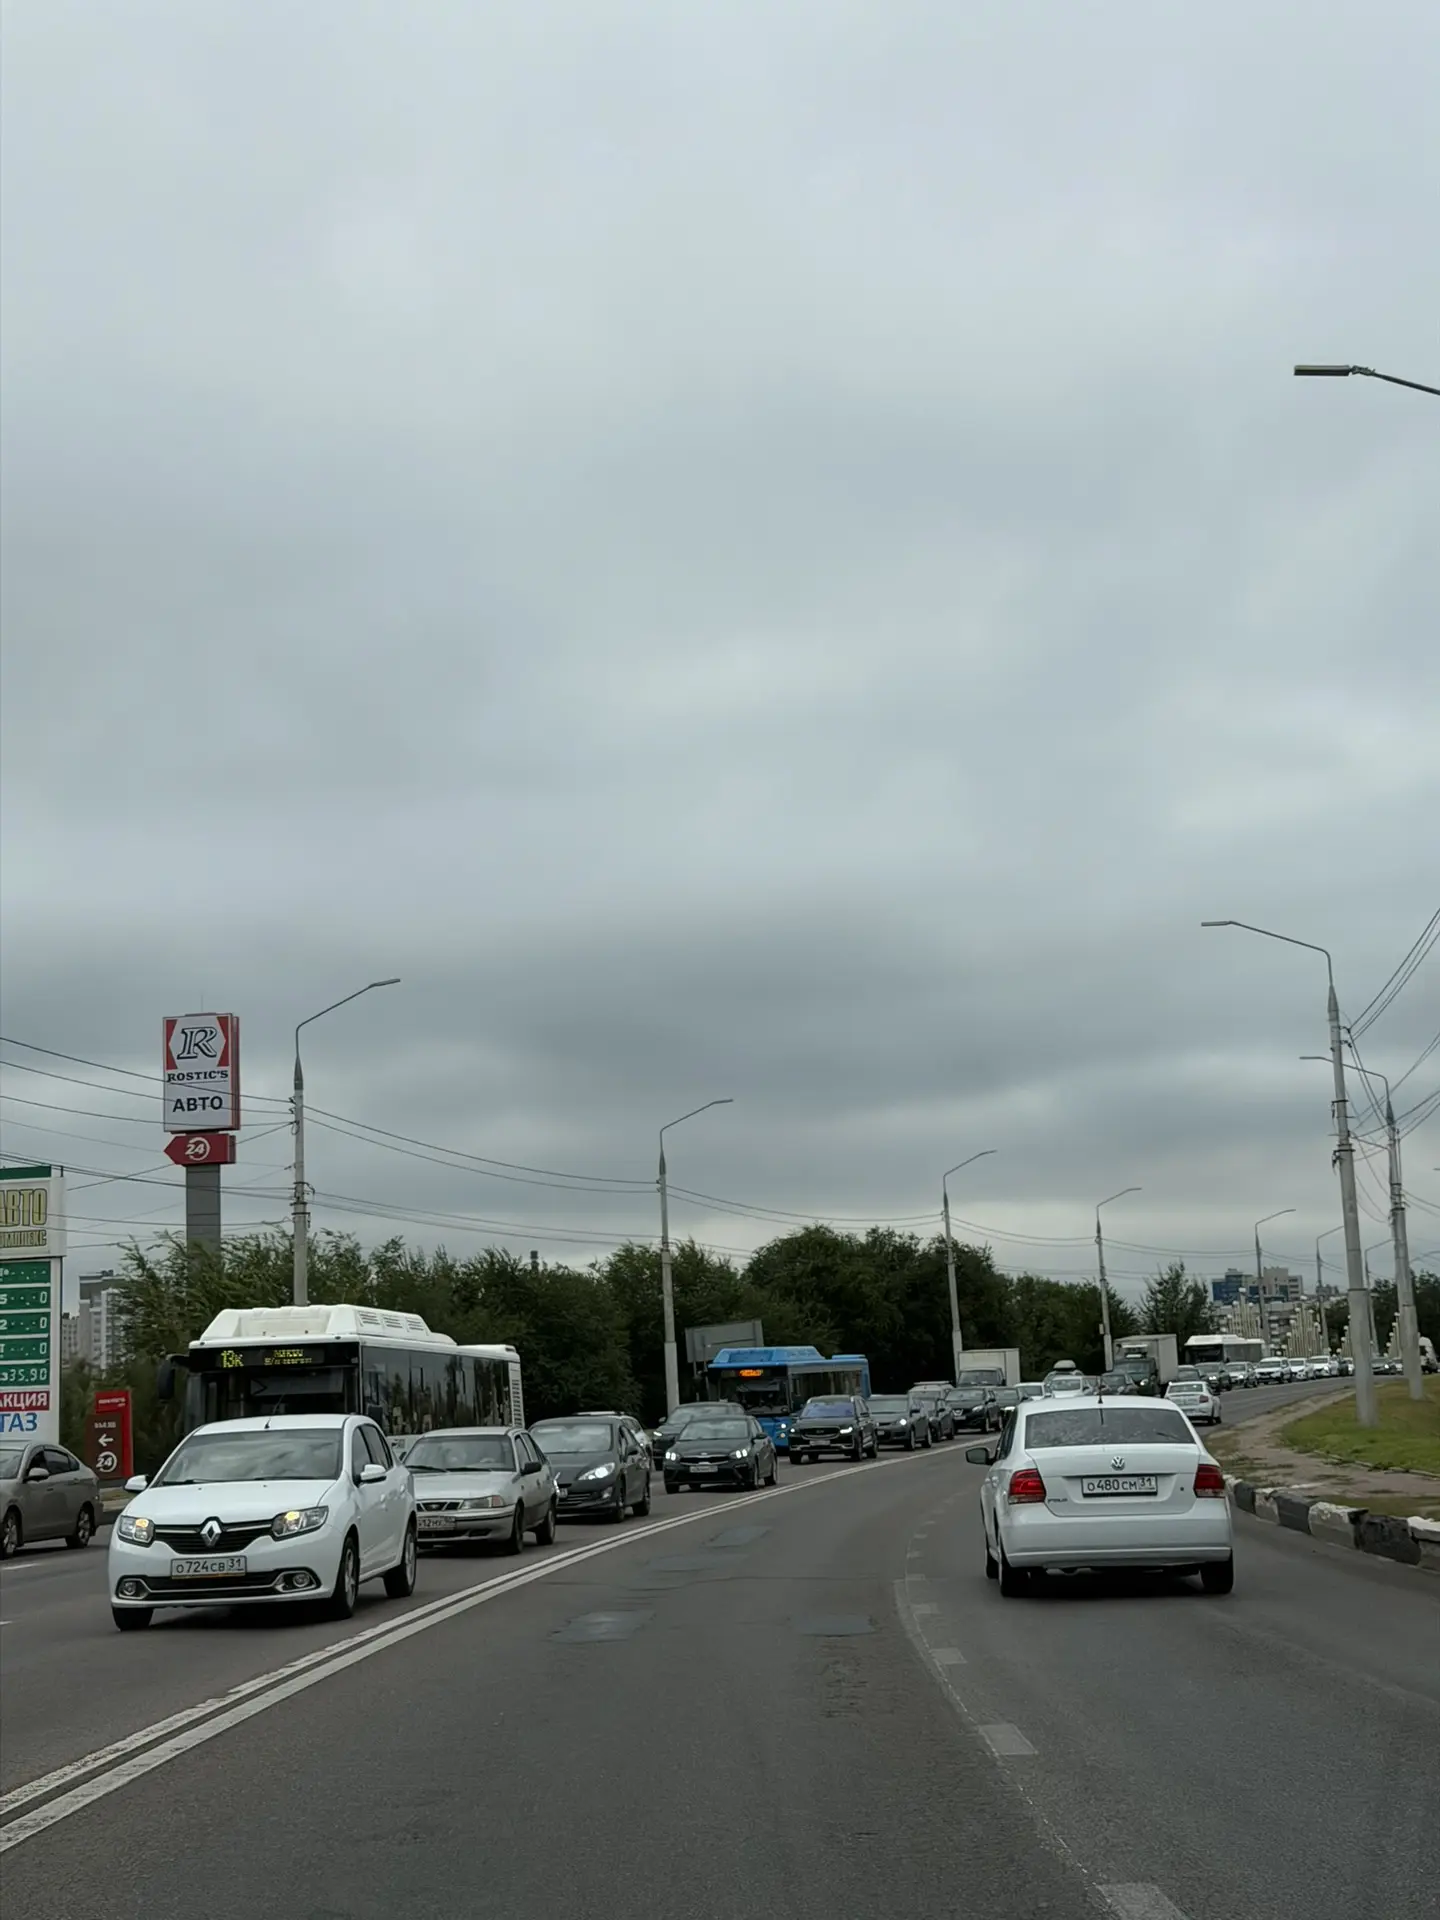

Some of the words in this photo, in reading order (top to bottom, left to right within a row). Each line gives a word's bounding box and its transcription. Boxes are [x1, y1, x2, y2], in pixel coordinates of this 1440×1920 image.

[167, 1070, 228, 1083] ROSTIC'S
[172, 1095, 223, 1112] АВТО
[184, 1143, 205, 1155] 24
